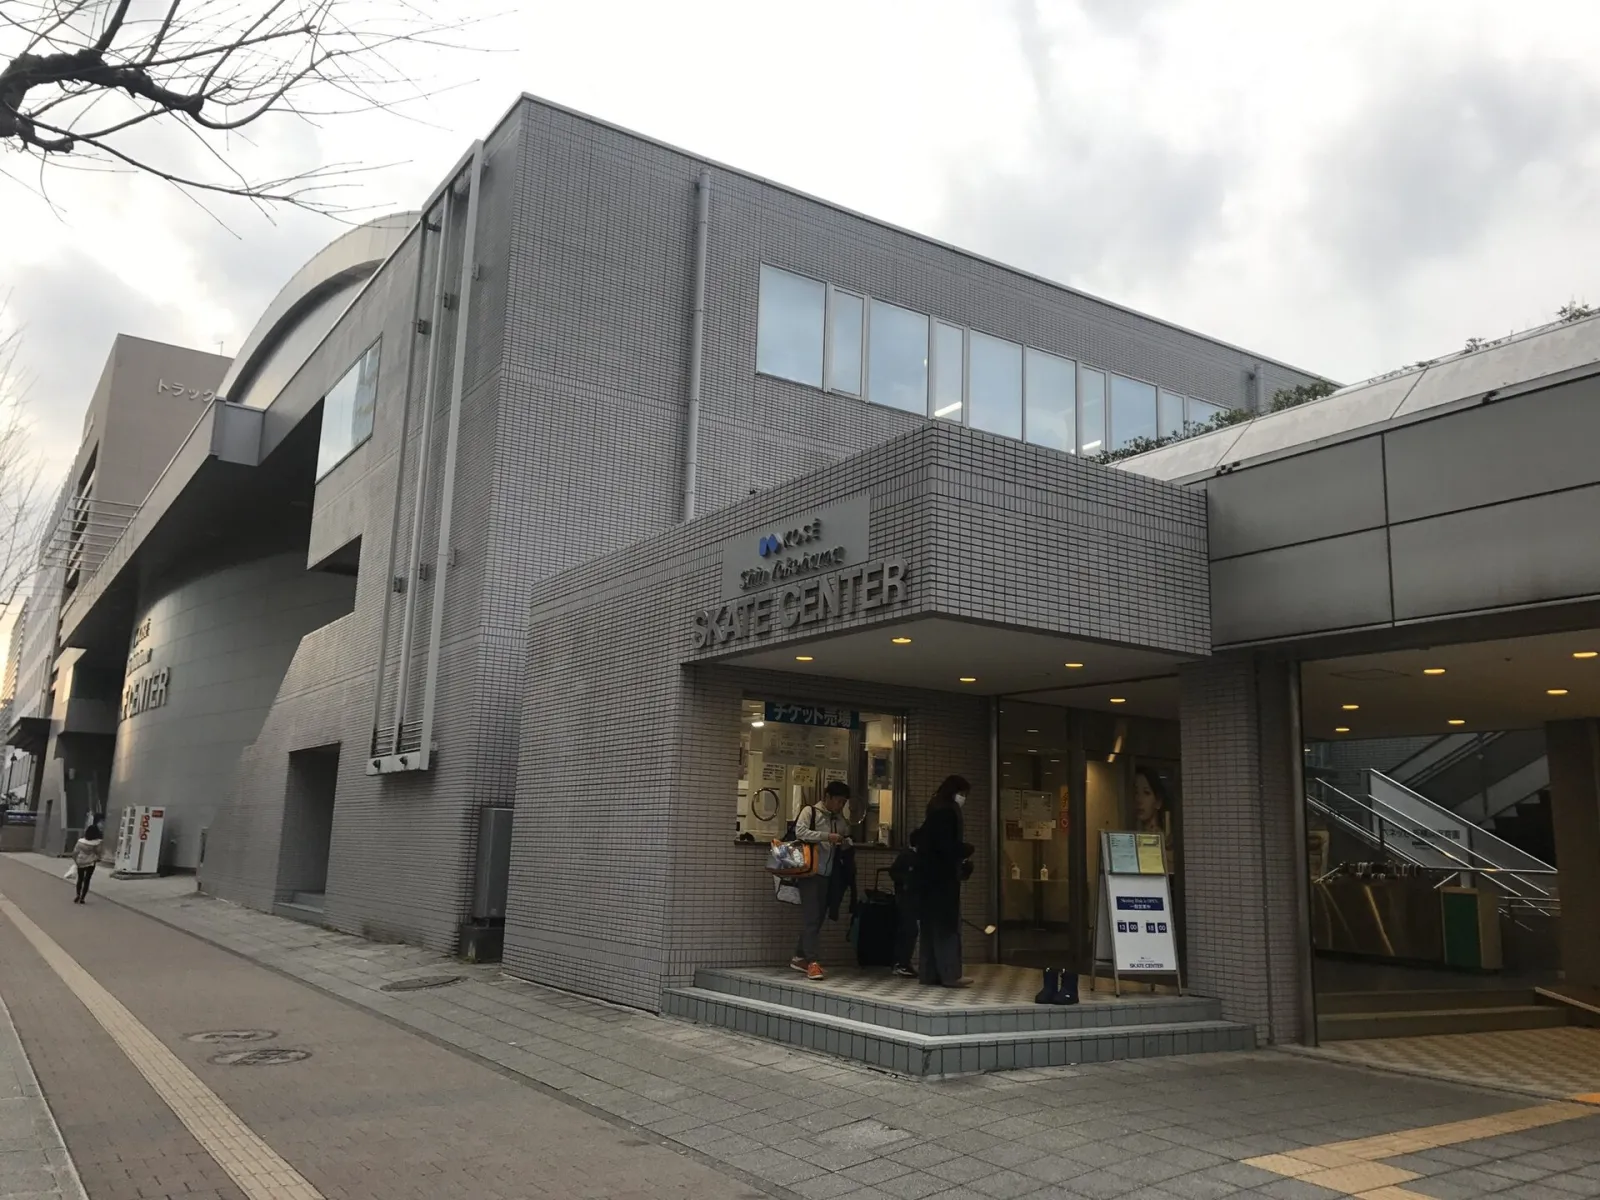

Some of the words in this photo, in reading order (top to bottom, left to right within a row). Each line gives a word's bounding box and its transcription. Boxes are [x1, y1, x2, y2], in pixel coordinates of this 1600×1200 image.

[692, 592, 773, 650] SKATE
[778, 555, 909, 629] CENTER
[773, 703, 852, 728] チケット売場
